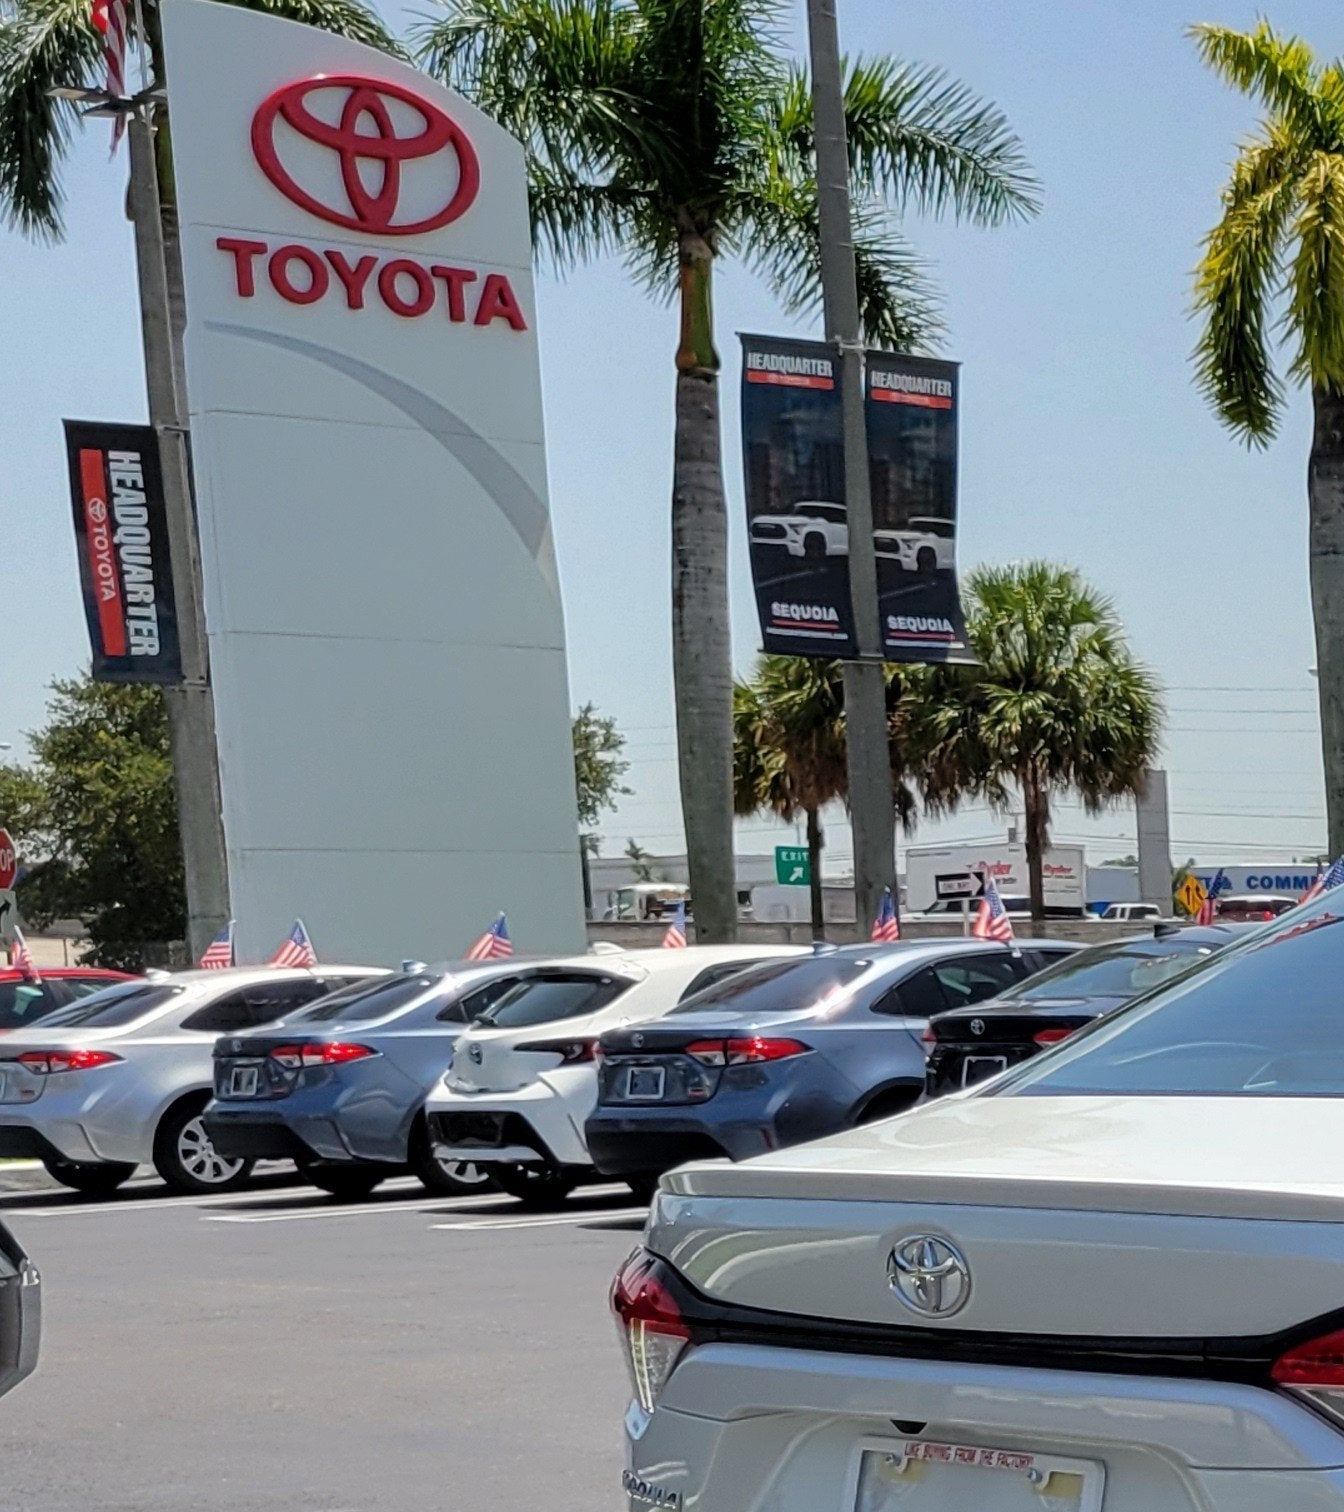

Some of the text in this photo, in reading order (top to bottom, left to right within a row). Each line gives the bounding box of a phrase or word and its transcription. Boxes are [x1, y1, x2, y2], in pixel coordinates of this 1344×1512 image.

[216, 236, 528, 331] TOYOTA
[748, 352, 833, 377] HEADQUARTER
[870, 371, 952, 397] HEADQUARTER
[93, 525, 117, 601] TOYOTA
[108, 450, 160, 657] HEADQUARTER
[771, 601, 839, 622] SEQUOIA
[887, 614, 955, 633] SEQUOIA
